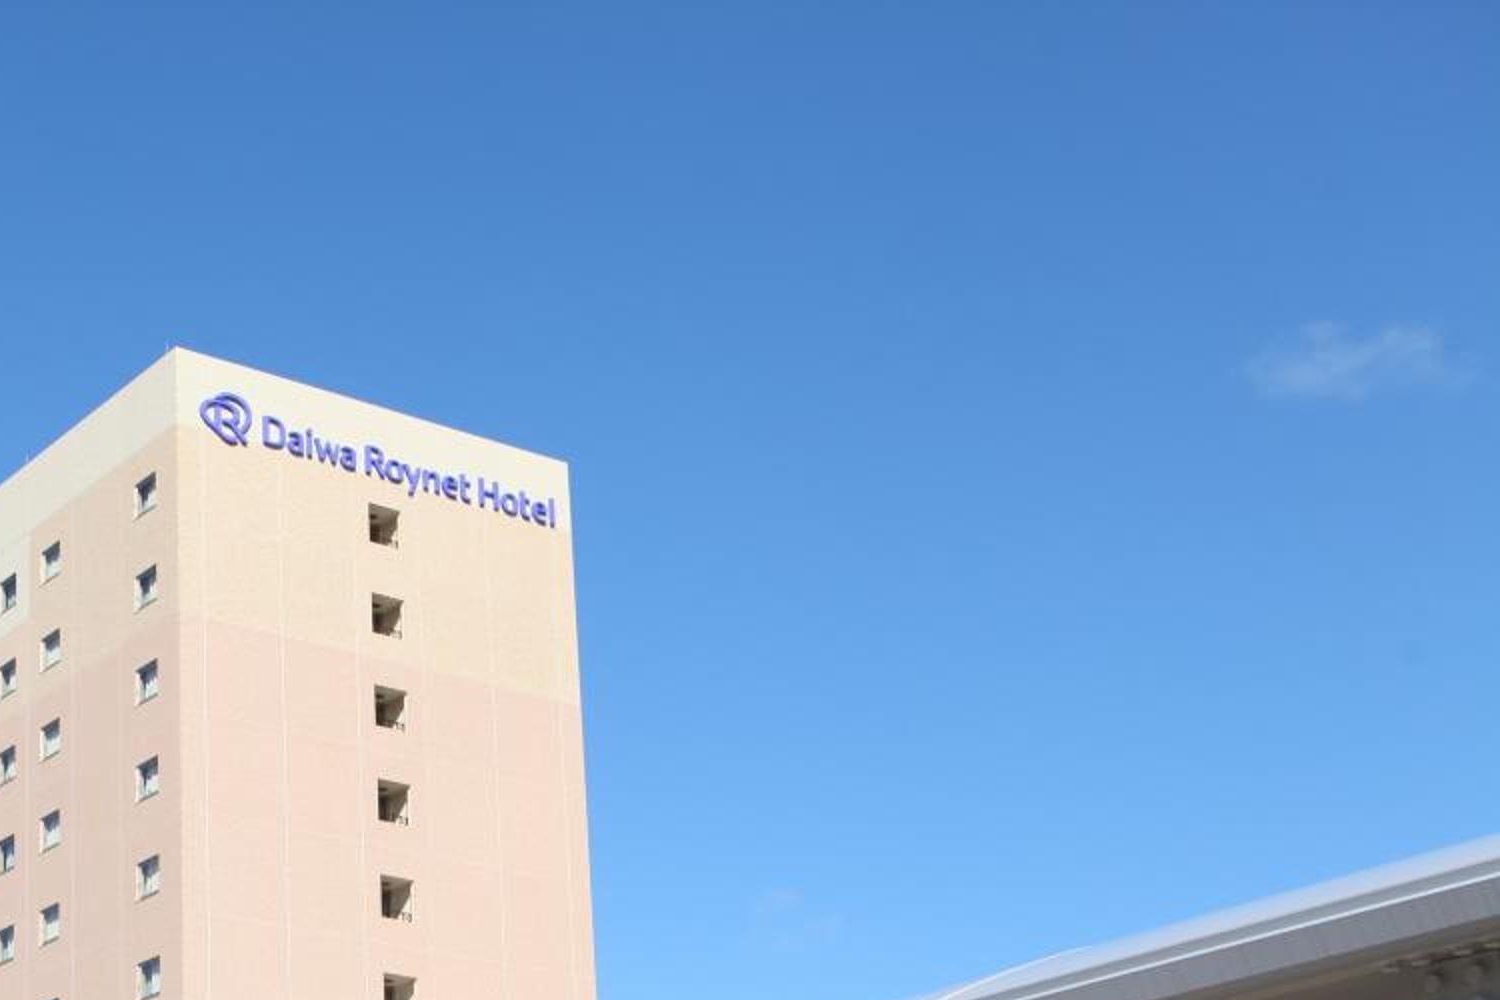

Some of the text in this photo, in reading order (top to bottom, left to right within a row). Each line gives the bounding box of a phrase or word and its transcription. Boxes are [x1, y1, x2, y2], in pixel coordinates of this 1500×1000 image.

[261, 415, 357, 472] Daiwa
[364, 444, 471, 504] Roynet
[478, 477, 555, 528] Hotel
